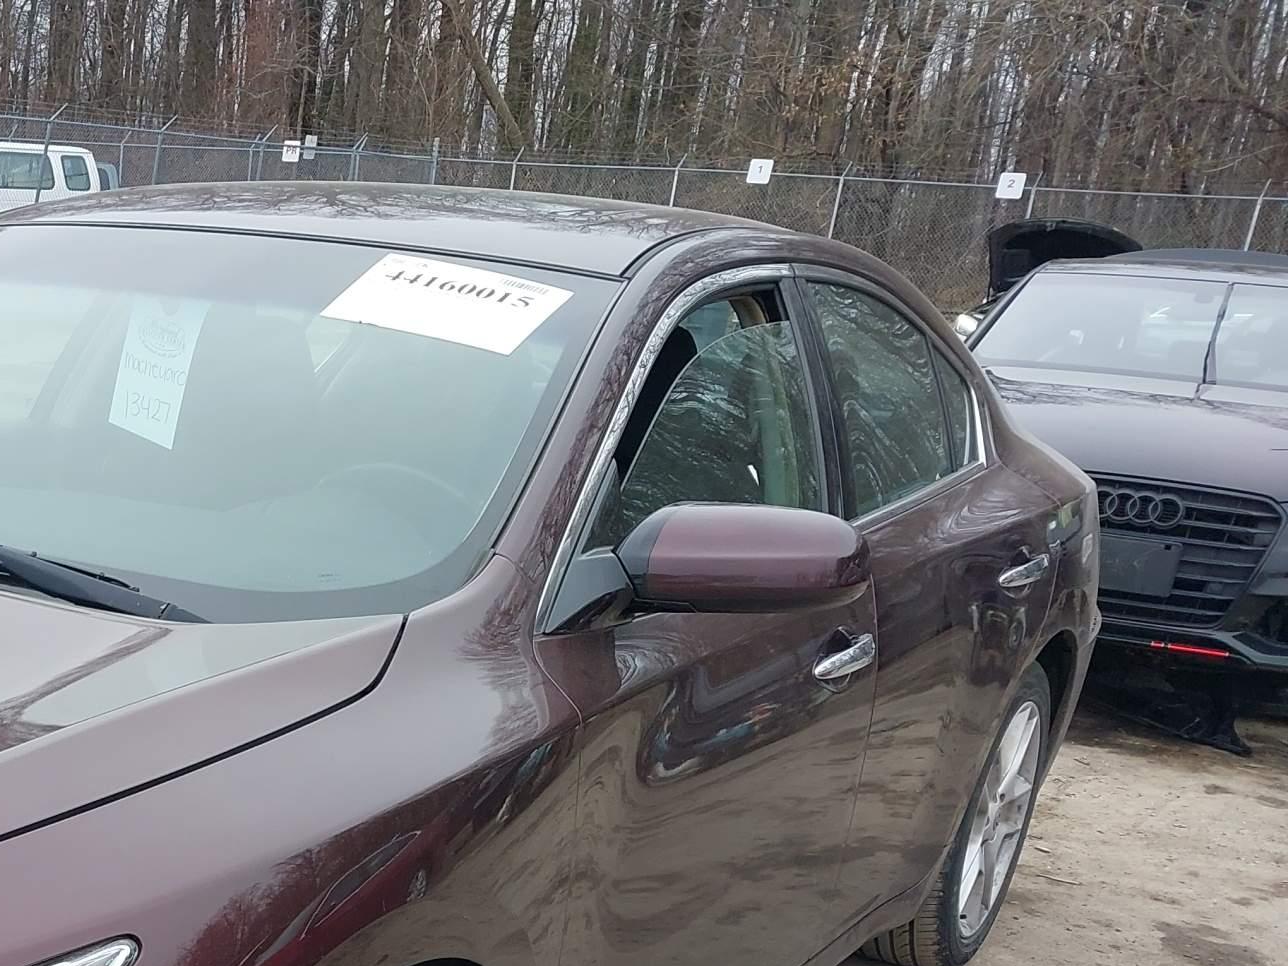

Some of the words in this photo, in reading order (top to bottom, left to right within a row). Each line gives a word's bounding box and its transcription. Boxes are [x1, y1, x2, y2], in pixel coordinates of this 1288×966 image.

[758, 165, 764, 174] 1
[1007, 179, 1016, 188] 2
[385, 270, 535, 307] 44160015
[124, 391, 172, 424] 13427
